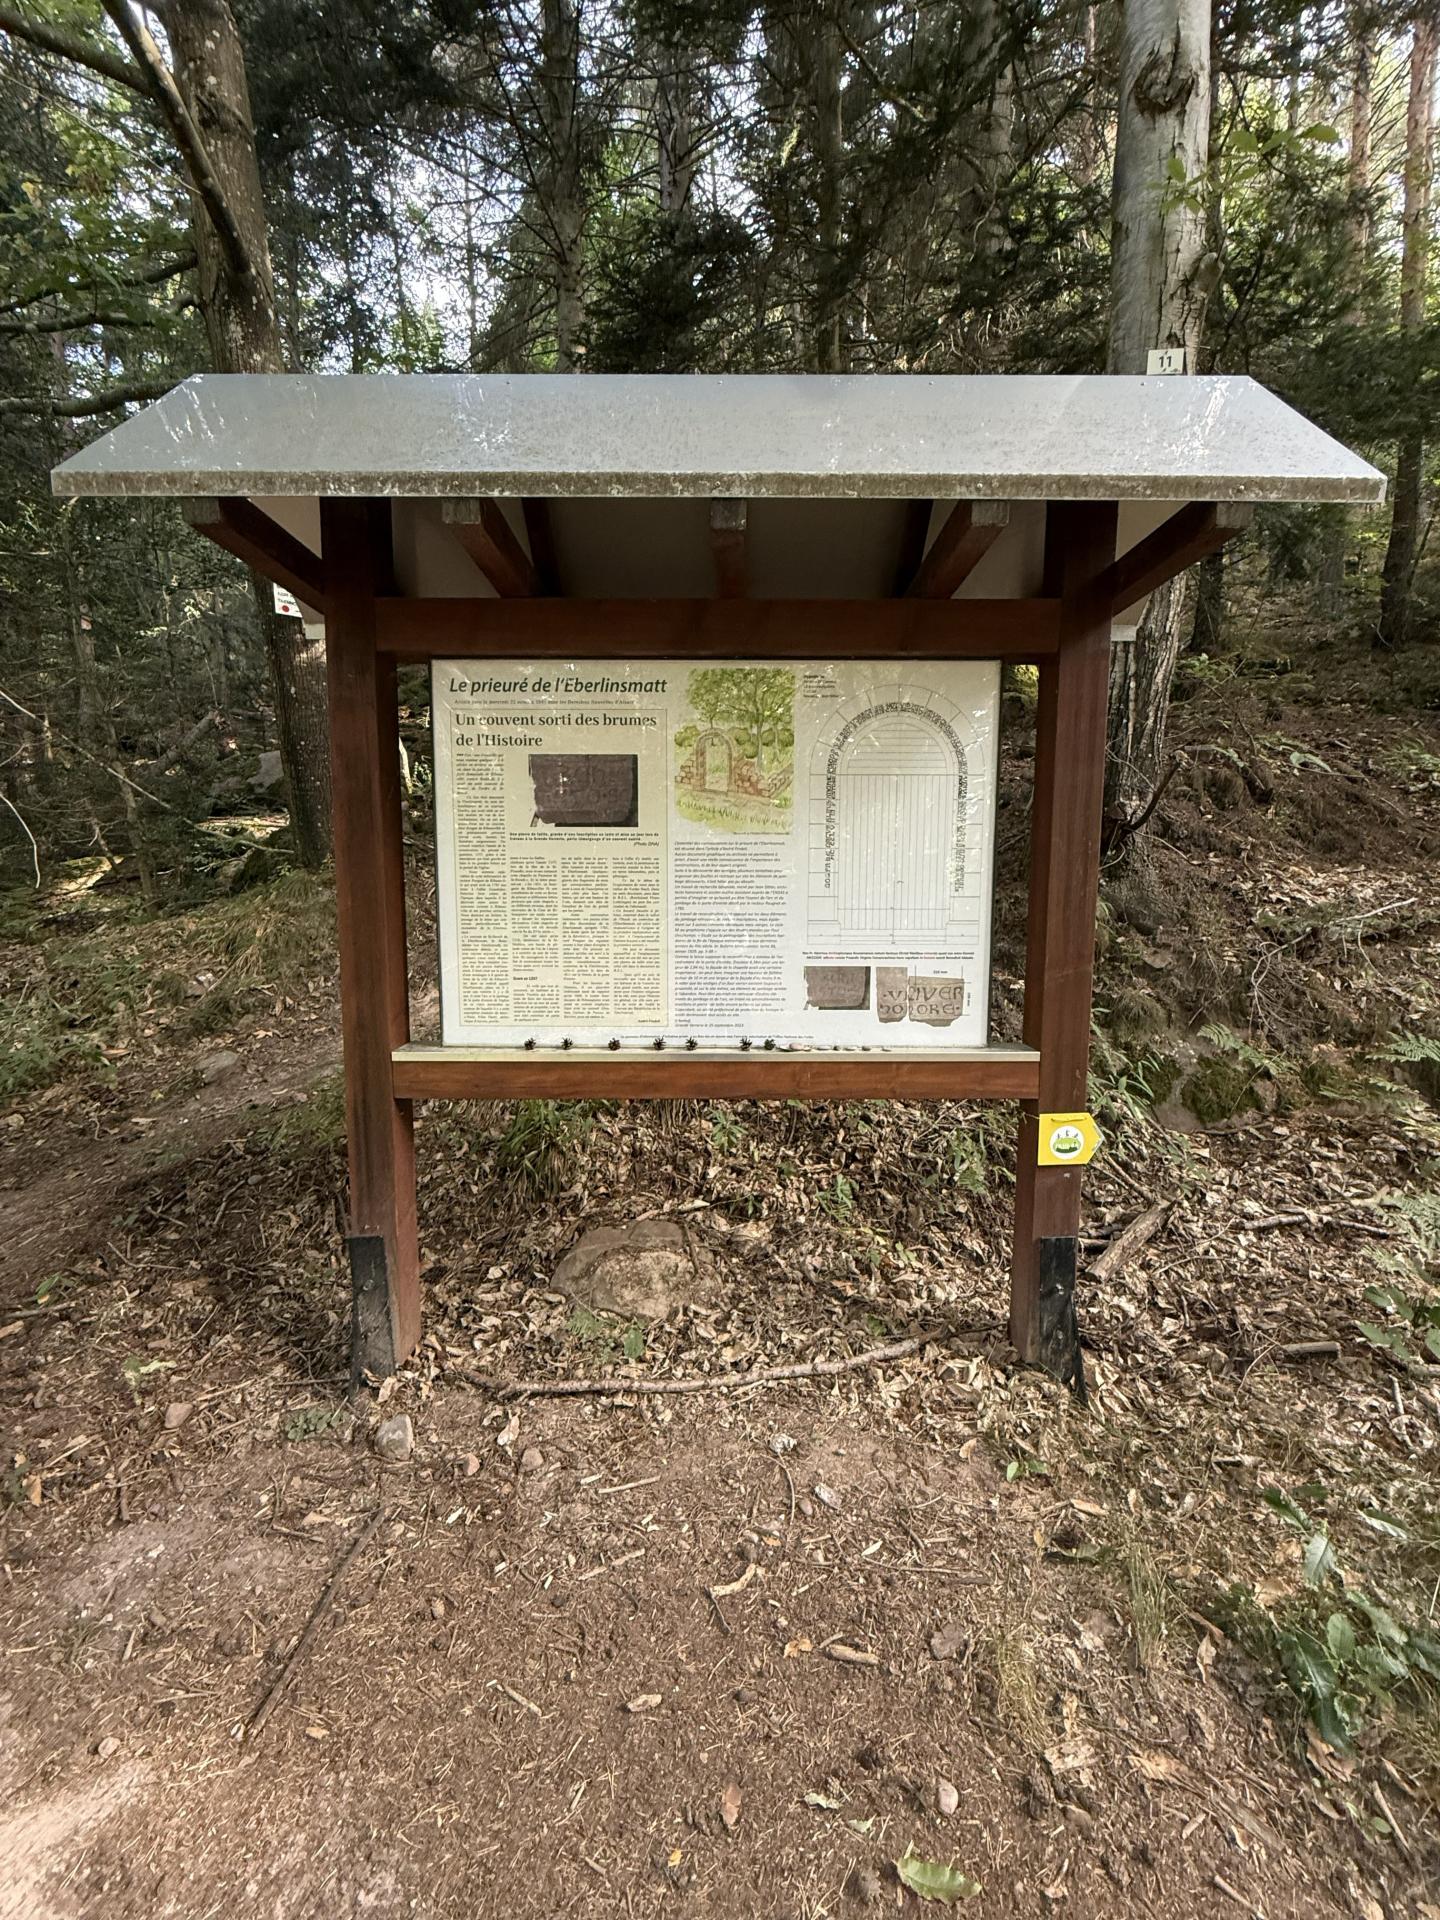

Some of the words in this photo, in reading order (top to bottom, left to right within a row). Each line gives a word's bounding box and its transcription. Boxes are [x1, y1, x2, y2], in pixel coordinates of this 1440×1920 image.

[1158, 355, 1172, 368] 11
[449, 678, 468, 693] Le
[470, 677, 529, 695] prieuré
[531, 677, 551, 693] de
[456, 713, 475, 726] Un
[479, 715, 535, 726] couvent
[538, 713, 570, 726] sorti
[575, 713, 600, 726] des
[602, 713, 657, 726] brumes
[455, 734, 474, 747] de
[477, 734, 543, 747] l'Histoire
